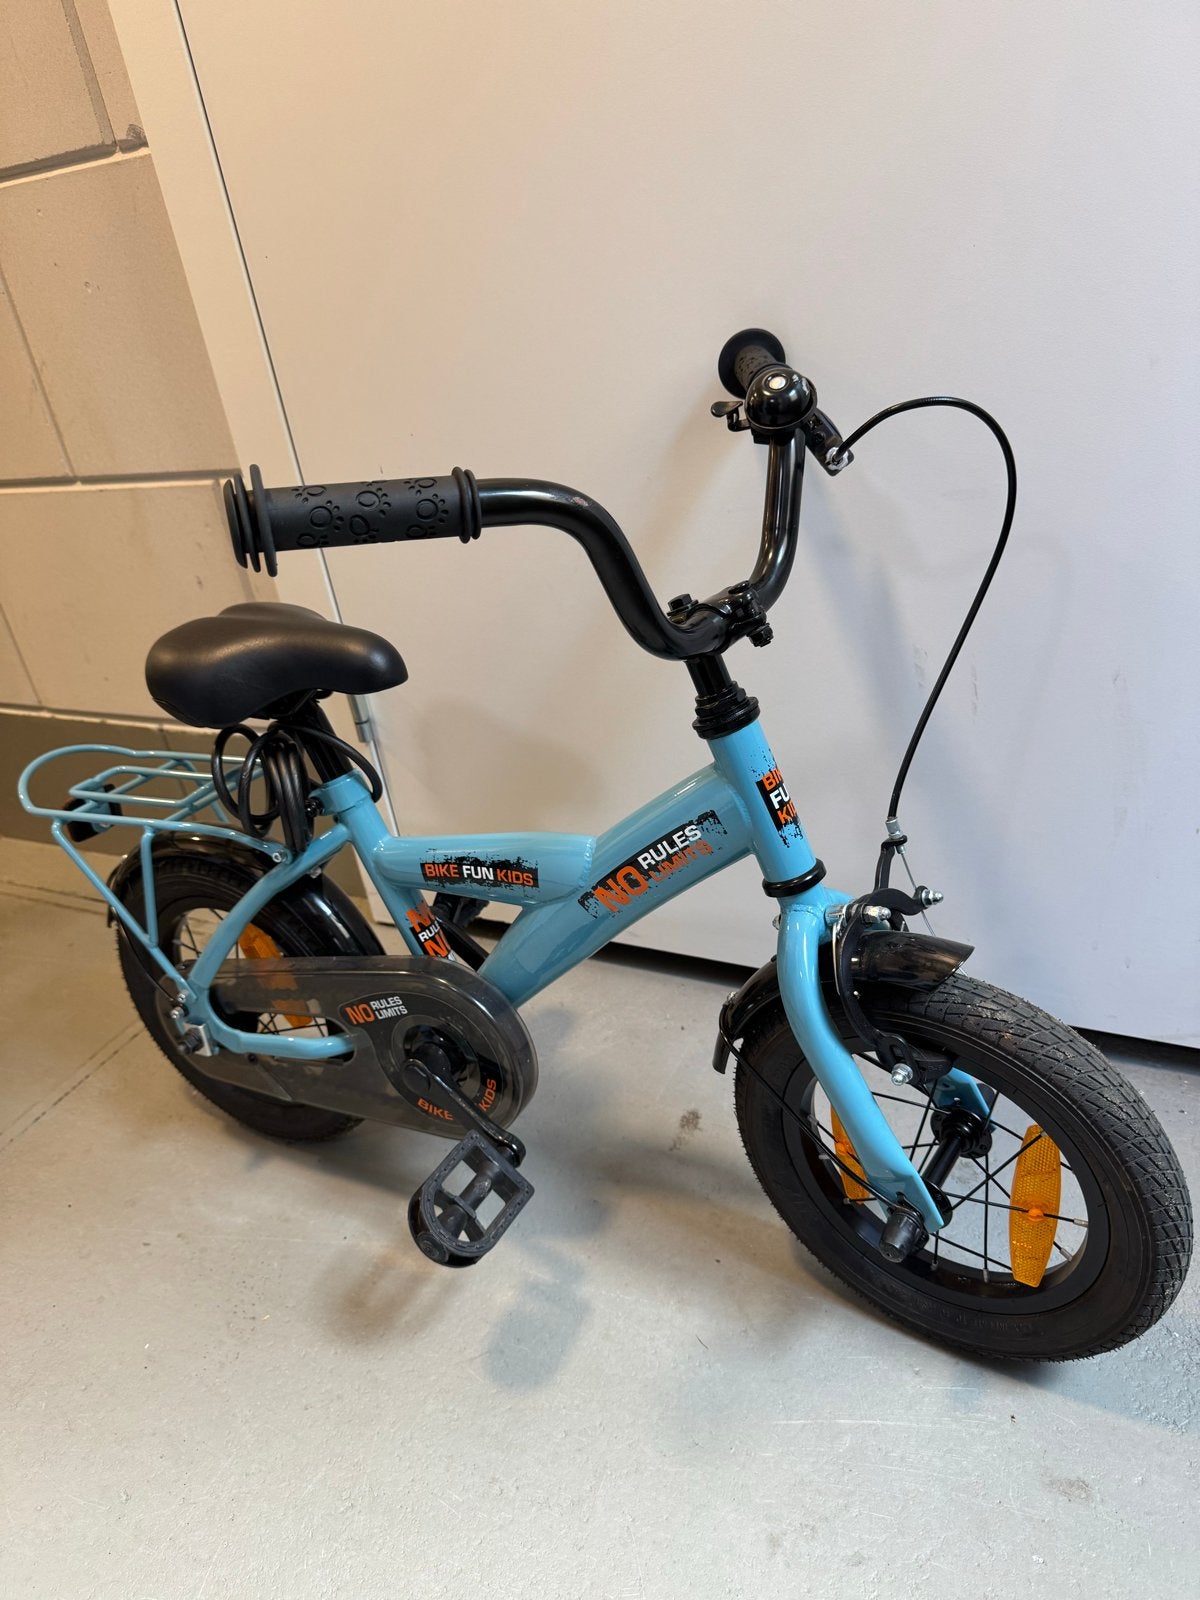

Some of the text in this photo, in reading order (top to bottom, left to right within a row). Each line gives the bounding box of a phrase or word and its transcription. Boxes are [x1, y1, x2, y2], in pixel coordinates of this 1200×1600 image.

[424, 863, 534, 887] BIKE FUN KIDS
[594, 824, 702, 913] NO RULES
[648, 840, 713, 883] LIMITS
[345, 996, 402, 1025] NO RULES
[375, 1005, 408, 1020] LIMITS
[417, 1078, 497, 1121] BIKE KIDS
